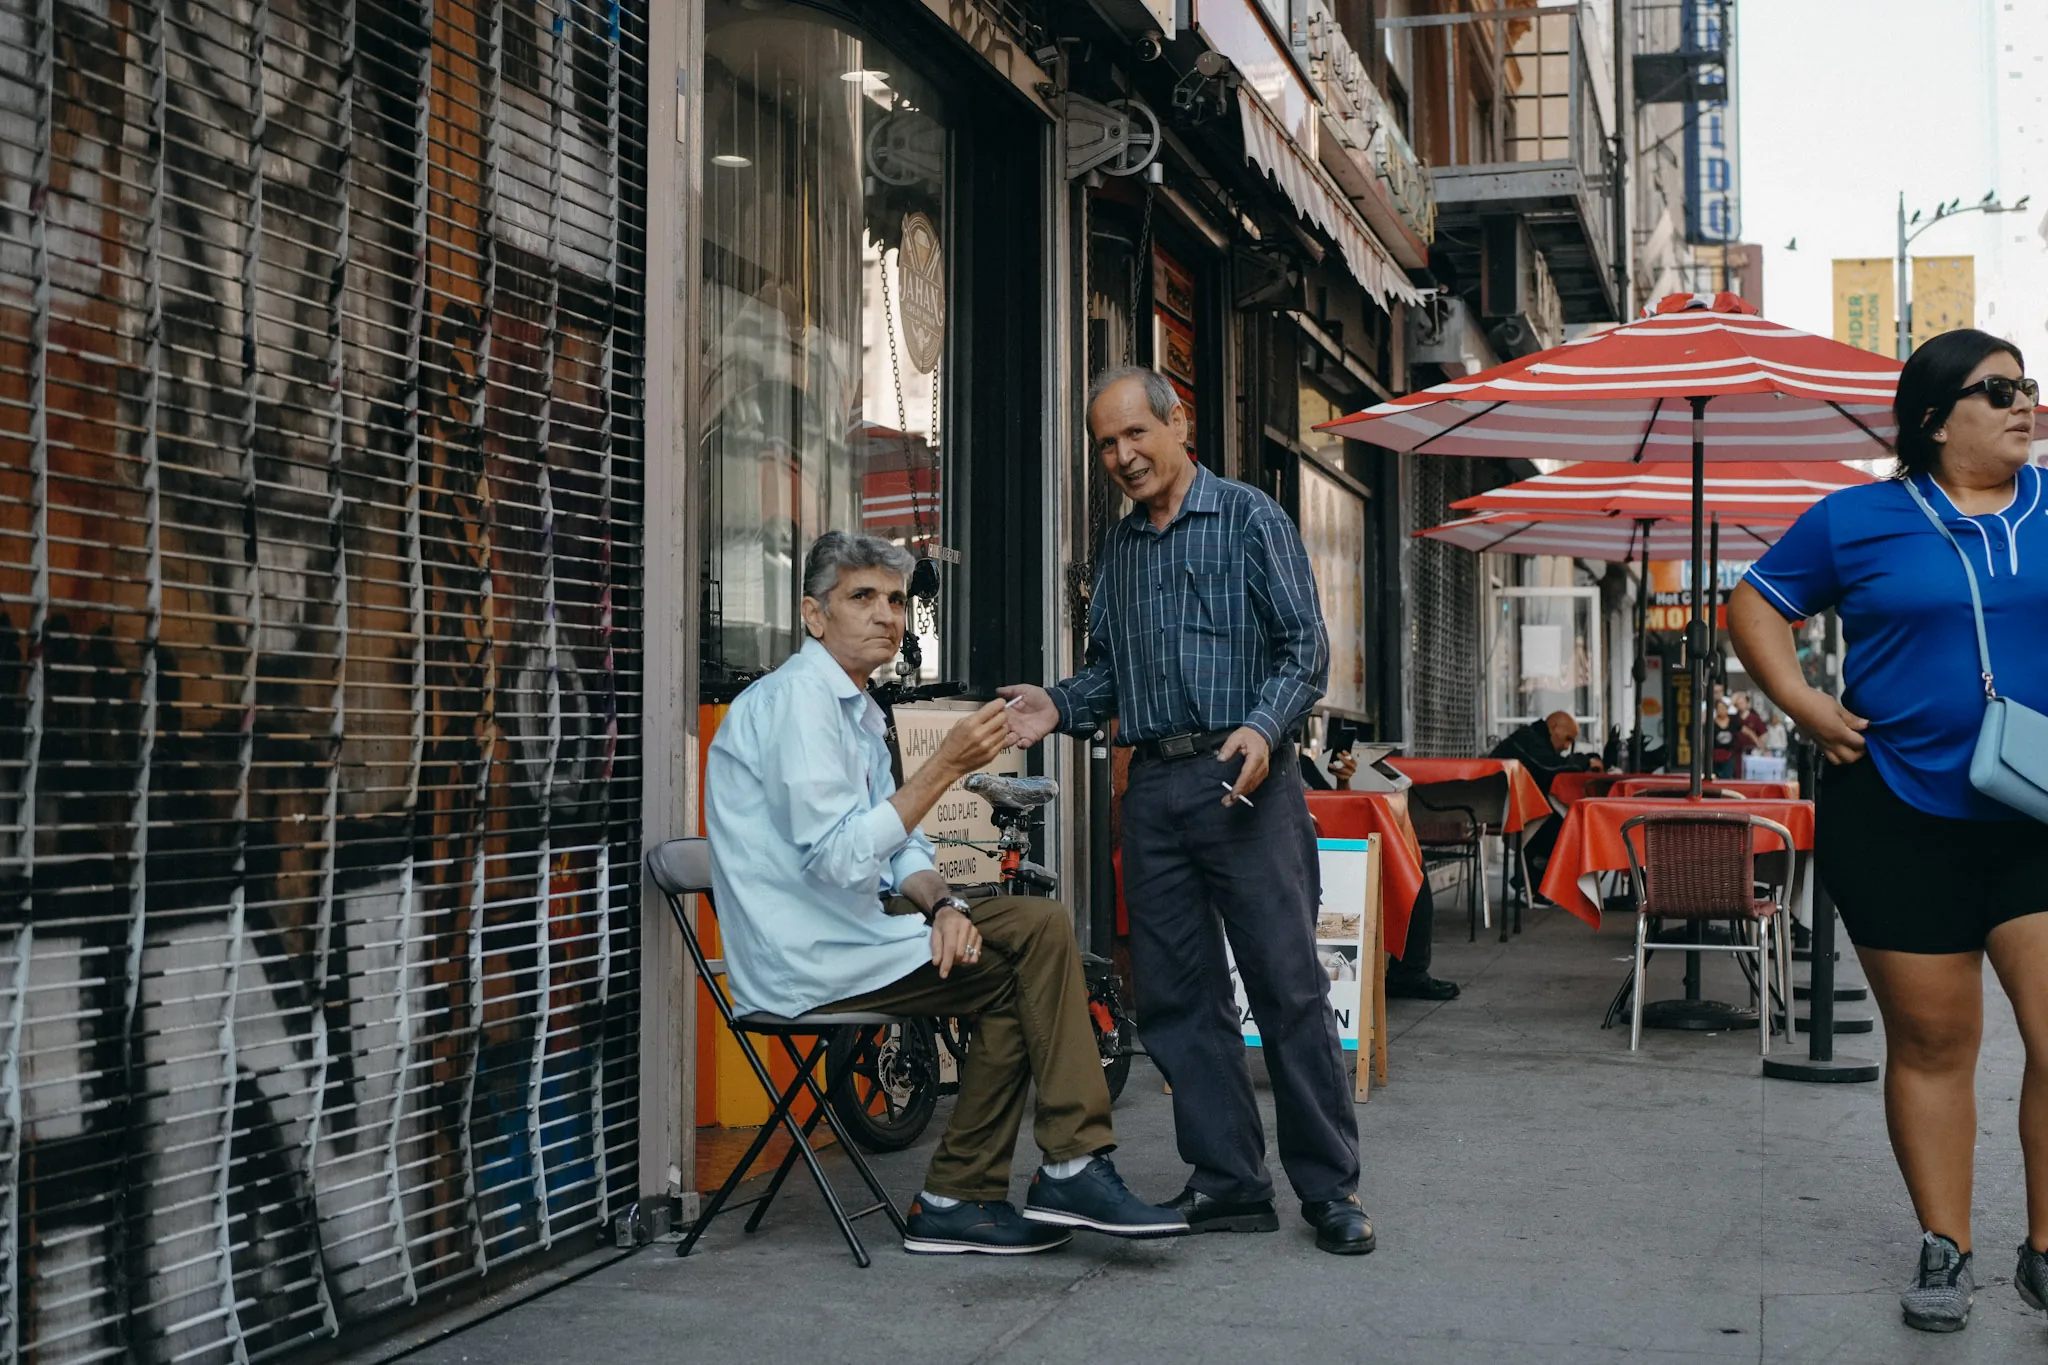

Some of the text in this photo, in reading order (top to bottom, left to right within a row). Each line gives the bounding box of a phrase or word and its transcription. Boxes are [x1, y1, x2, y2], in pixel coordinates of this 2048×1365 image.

[900, 266, 944, 327] JAHAN
[1848, 295, 1864, 350] PIDER
[1868, 293, 1880, 354] AVILION
[906, 728, 943, 757] JAHAN
[937, 801, 978, 822] GOLD PLATE
[938, 828, 969, 849] RHODIUM
[939, 857, 977, 880] ENGRAVING
